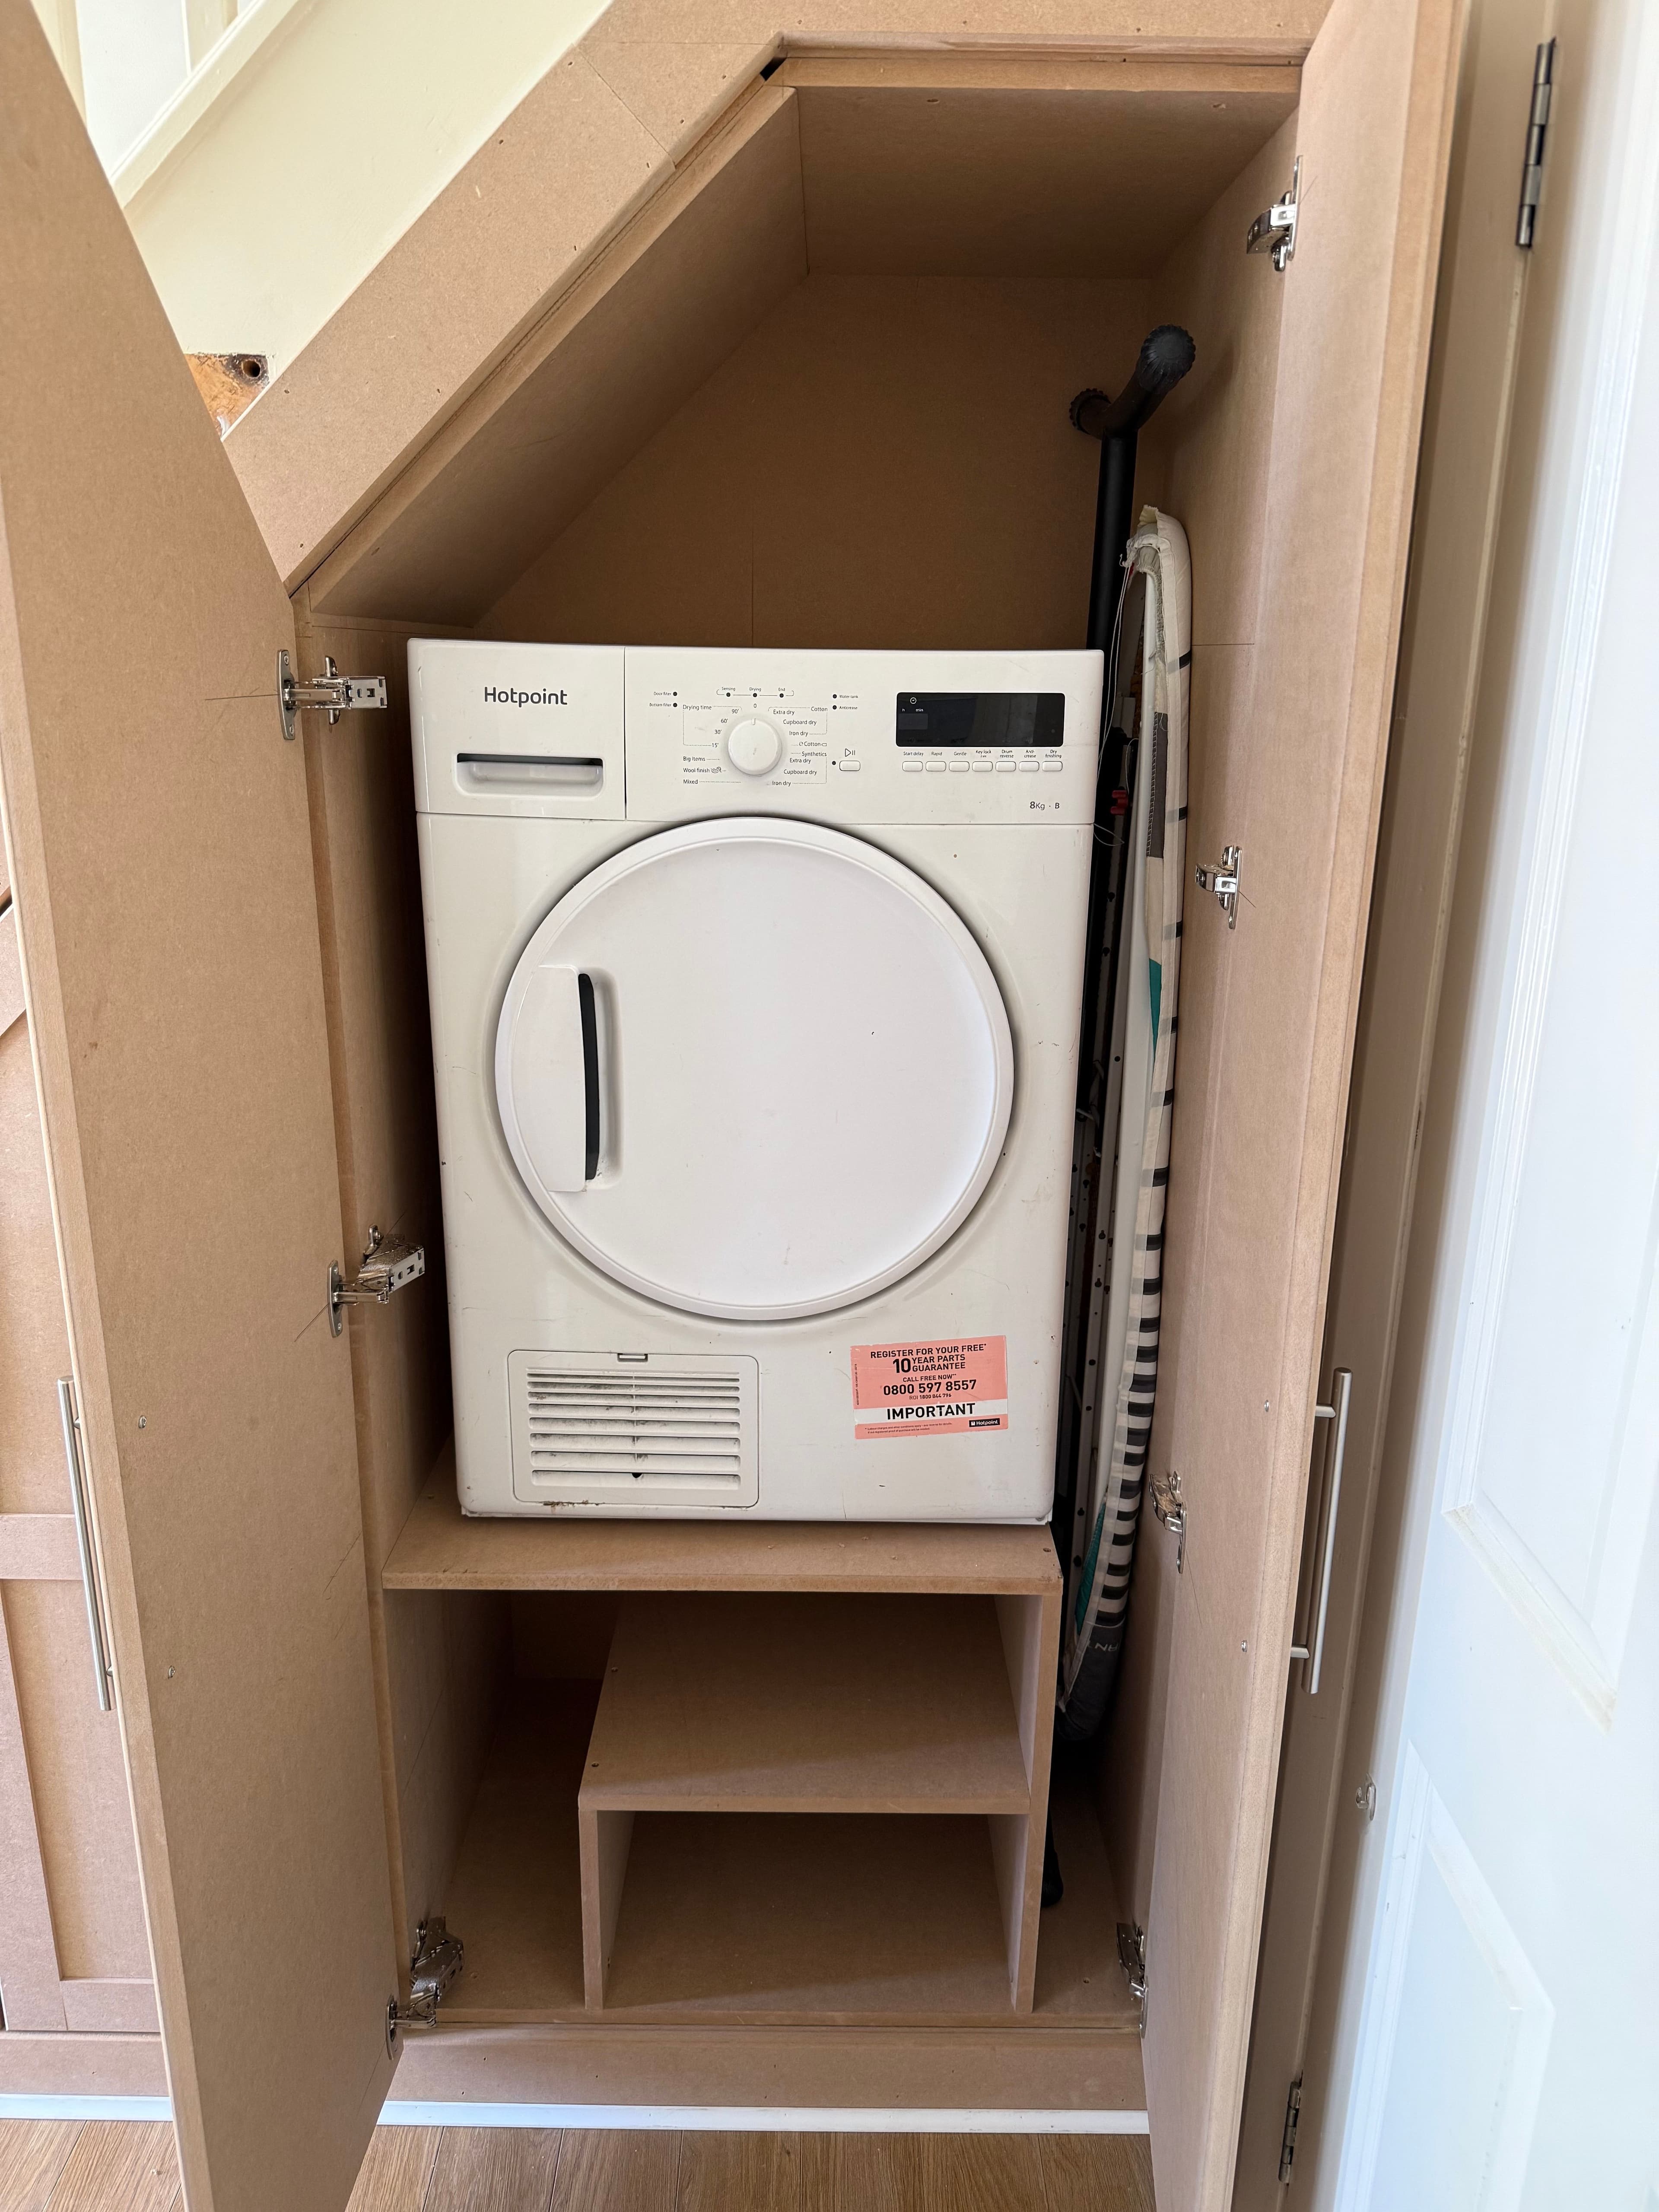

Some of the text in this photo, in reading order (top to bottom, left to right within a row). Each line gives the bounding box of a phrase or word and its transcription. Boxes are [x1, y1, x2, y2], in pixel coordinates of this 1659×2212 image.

[485, 687, 567, 707] Hotpoint
[1030, 801, 1045, 810] 8Kg
[870, 1349, 913, 1359] REGISTER
[916, 1348, 933, 1356] FOR
[935, 1346, 960, 1354] YOUR
[893, 1358, 912, 1373] 10
[937, 1354, 966, 1362] PARTS
[912, 1362, 966, 1372] GUARANTEE
[883, 1379, 977, 1395] 0800 597 8557
[887, 1402, 976, 1420] IMPORTANT
